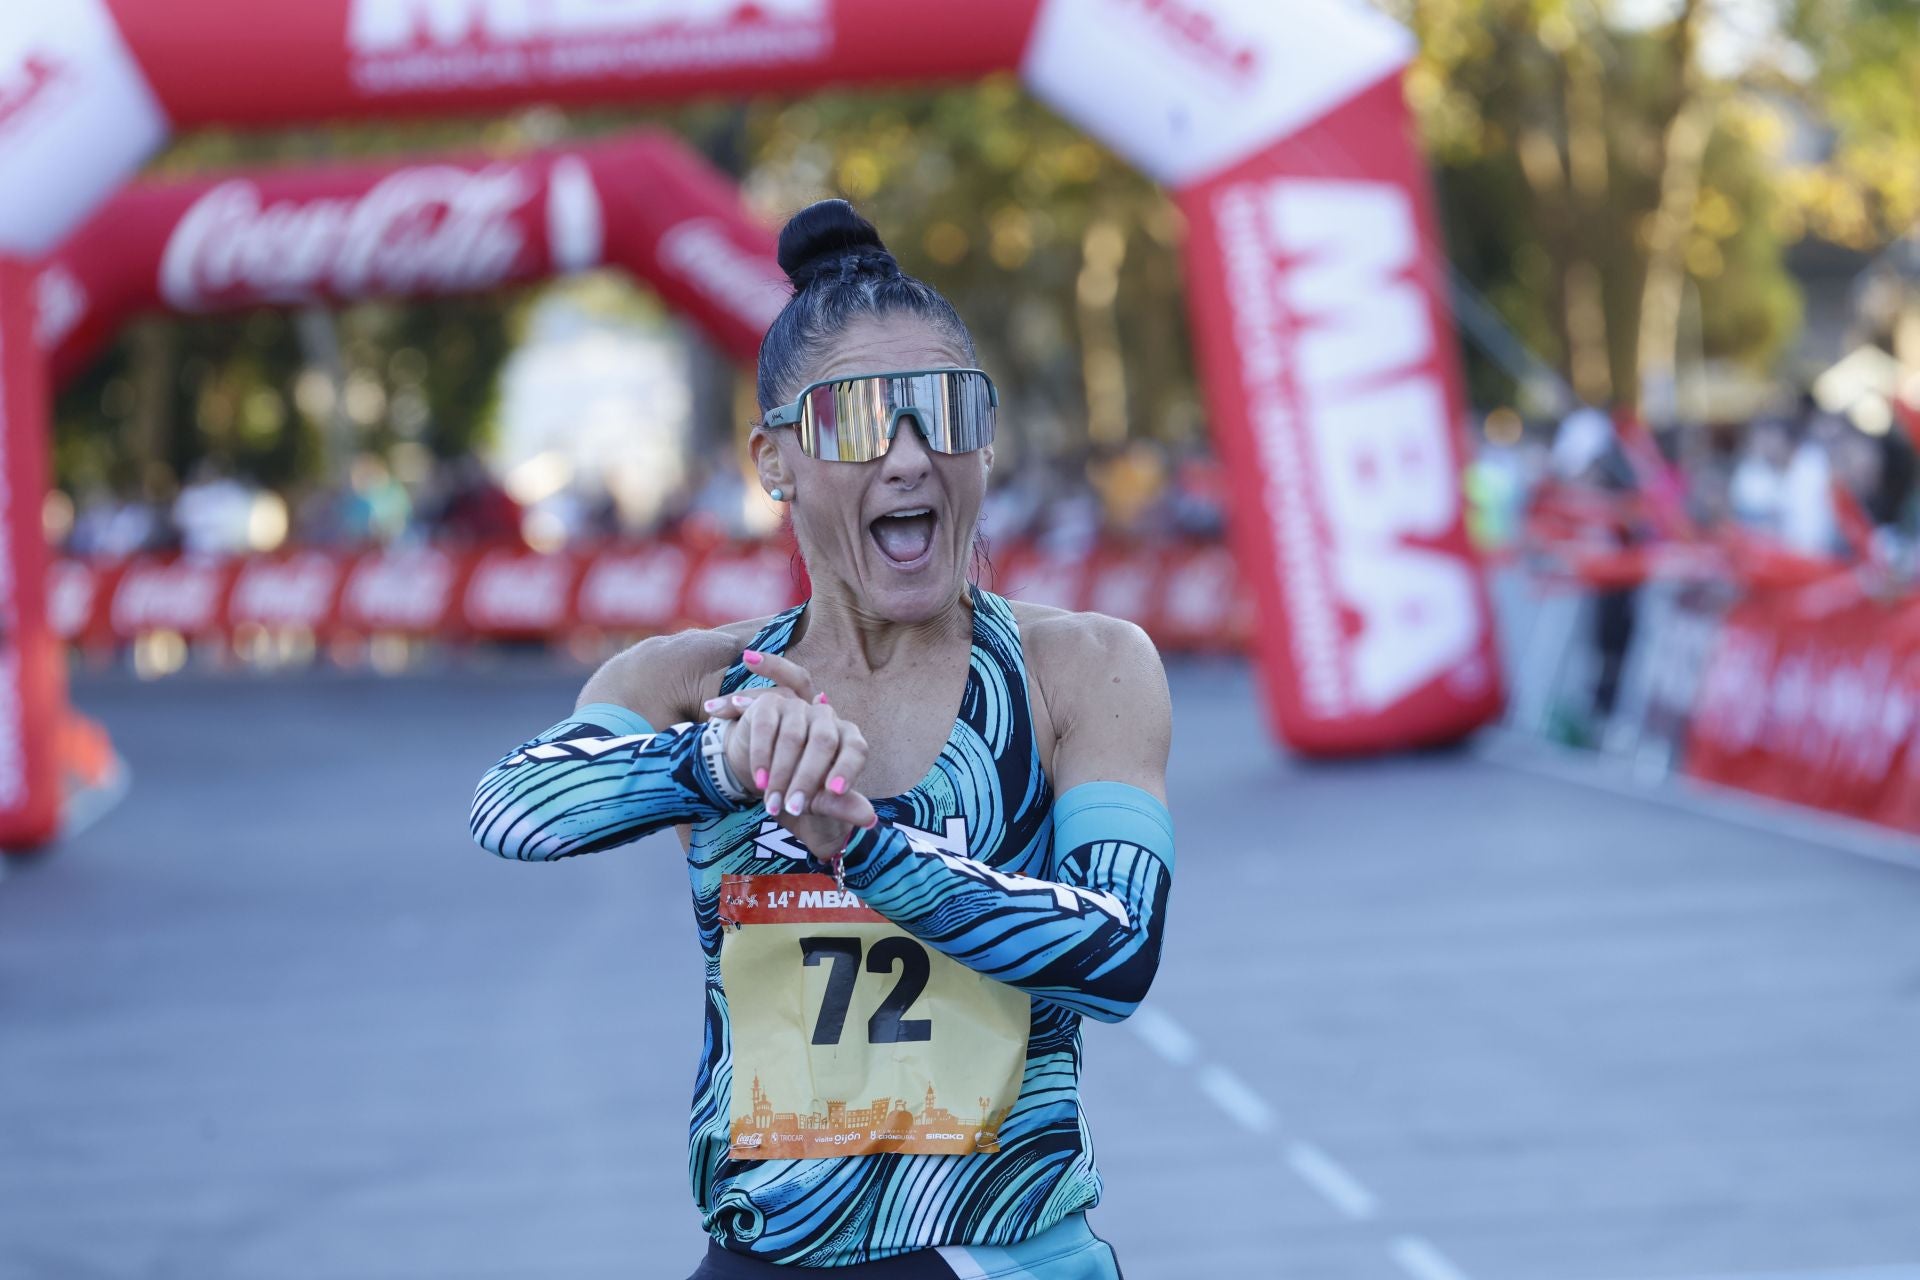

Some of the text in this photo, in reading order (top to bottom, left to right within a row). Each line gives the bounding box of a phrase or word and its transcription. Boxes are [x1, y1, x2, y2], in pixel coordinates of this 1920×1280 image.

[1270, 177, 1483, 713] MBA
[798, 890, 860, 909] MBA
[799, 936, 932, 1045] 72
